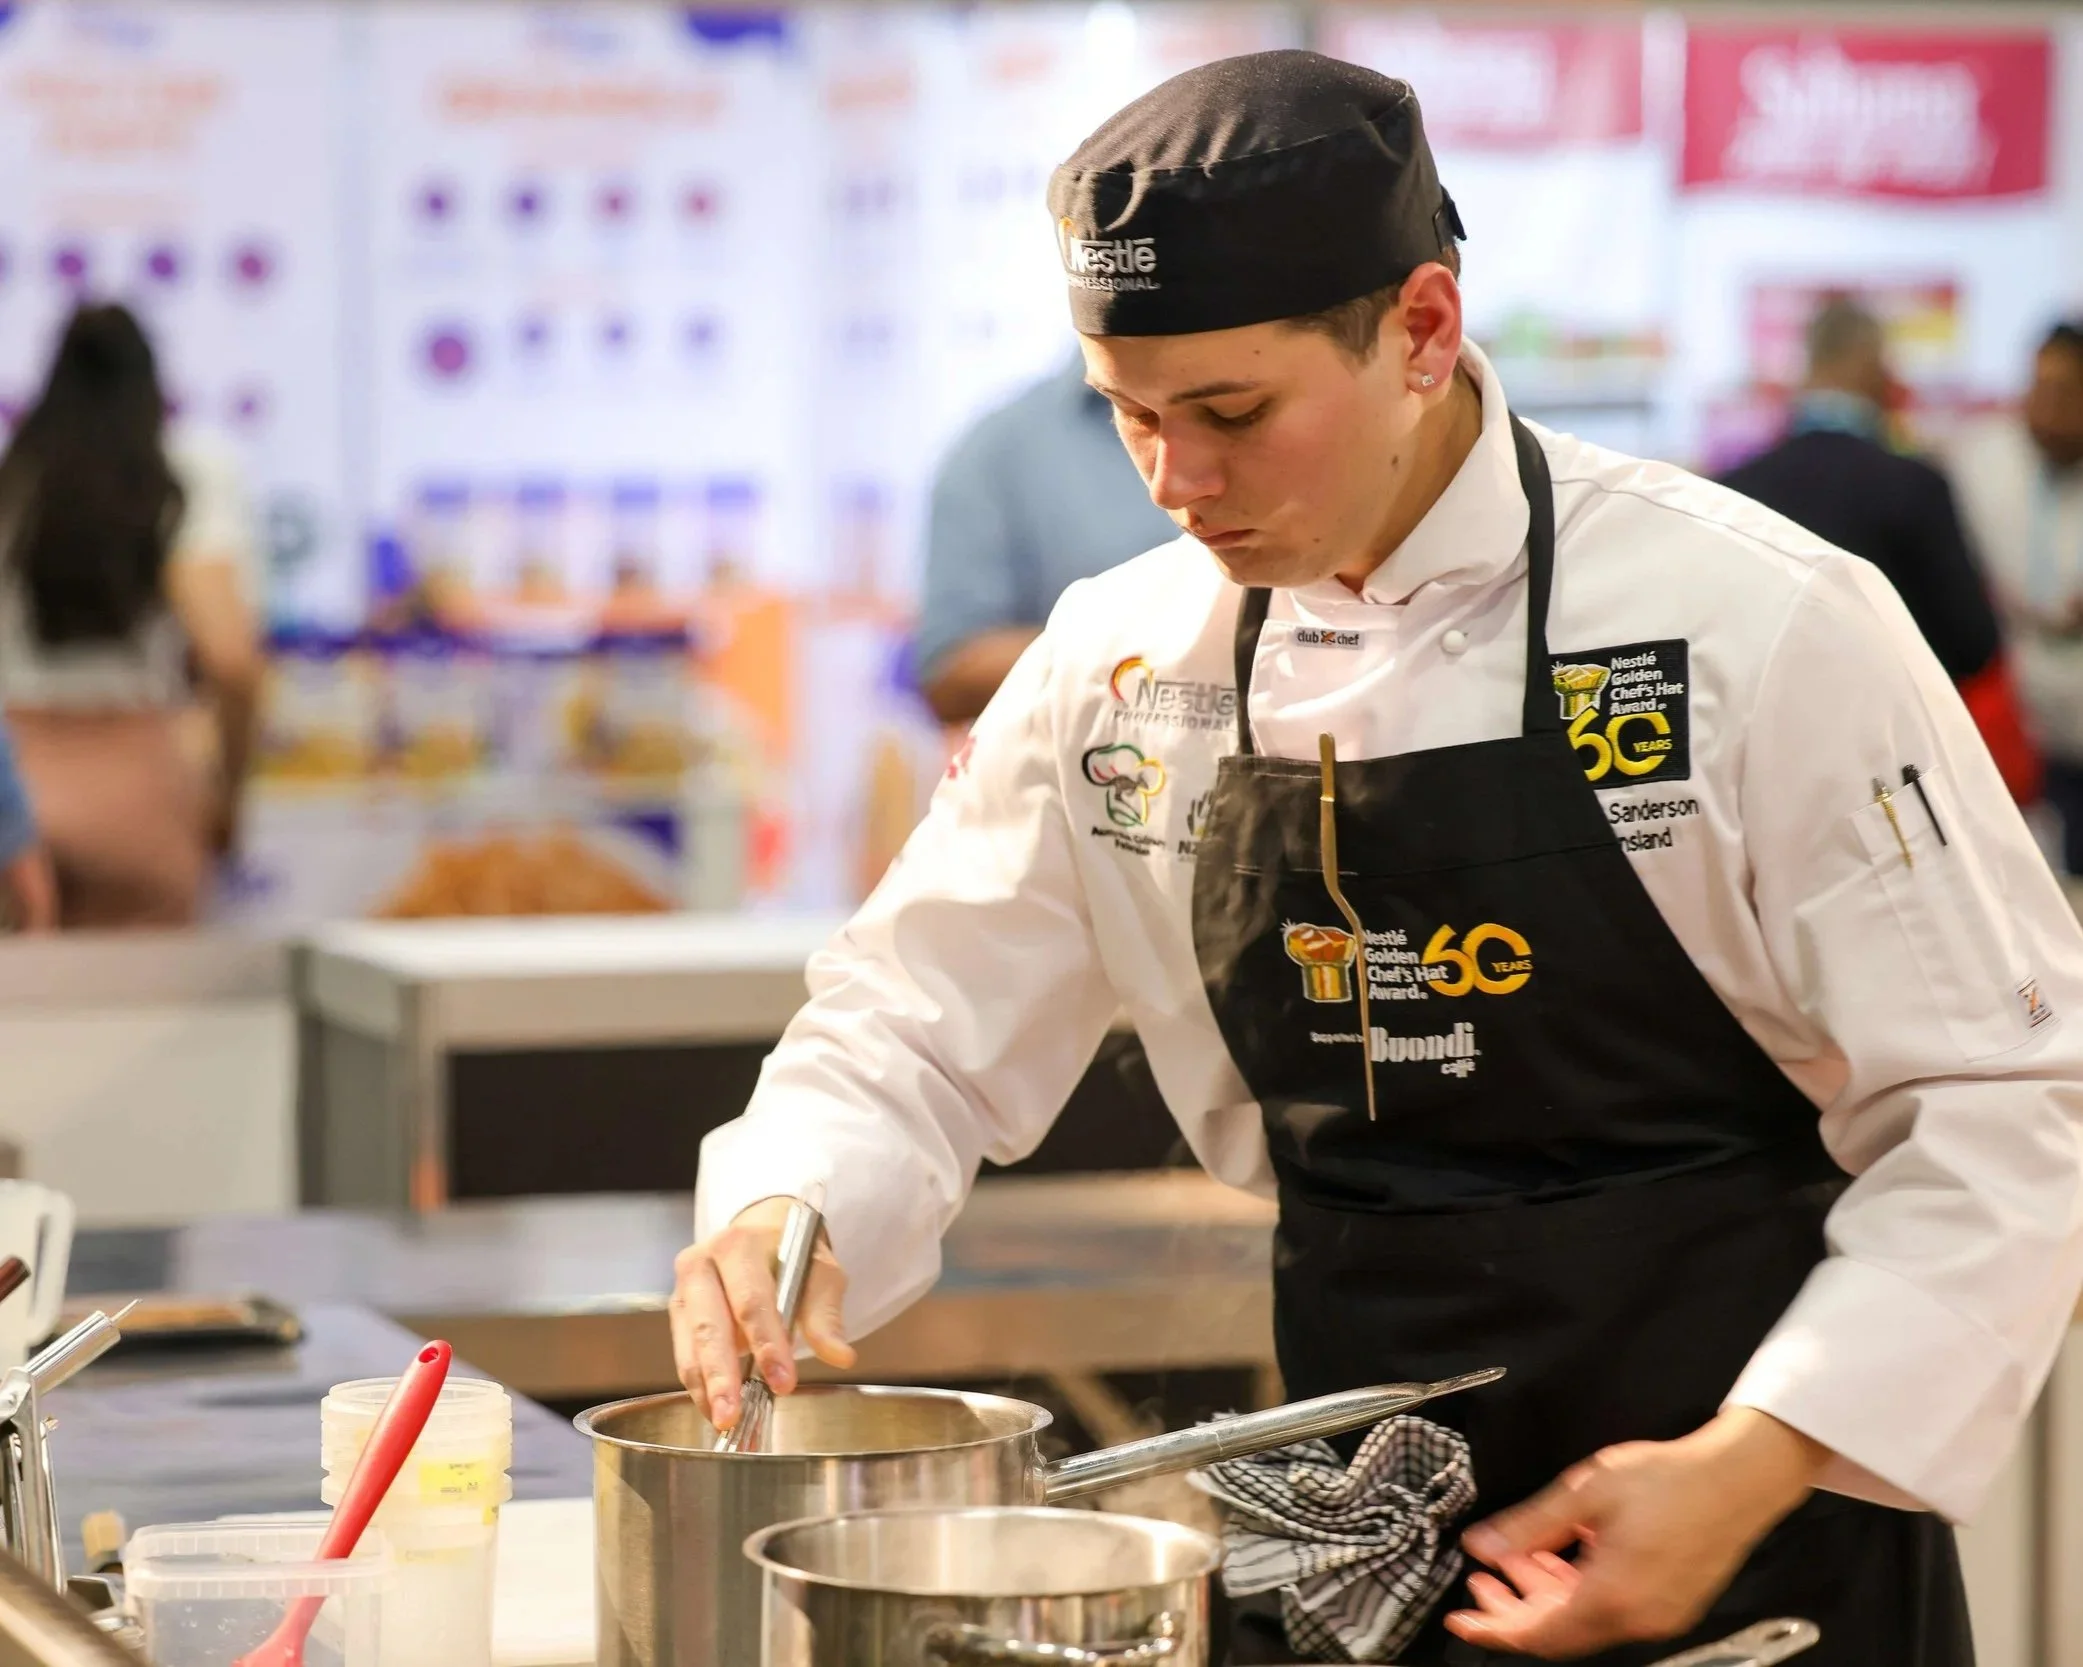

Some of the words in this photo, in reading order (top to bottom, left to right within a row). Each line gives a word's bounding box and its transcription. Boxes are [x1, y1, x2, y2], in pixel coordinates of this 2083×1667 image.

[1297, 629, 1319, 643] club
[1337, 633, 1359, 645] chef
[1611, 651, 1657, 670] Nestlé
[1611, 668, 1663, 686] Golden
[1610, 684, 1654, 701] Chef's
[1655, 682, 1685, 696] Hat
[1633, 739, 1673, 753] YEARS
[1609, 798, 1699, 824] Sanderson
[1619, 827, 1673, 853] nsland
[1364, 947, 1420, 964] Golden
[1367, 965, 1414, 983] Chef's
[1413, 965, 1449, 982] Hat
[1492, 960, 1532, 973] YEARS
